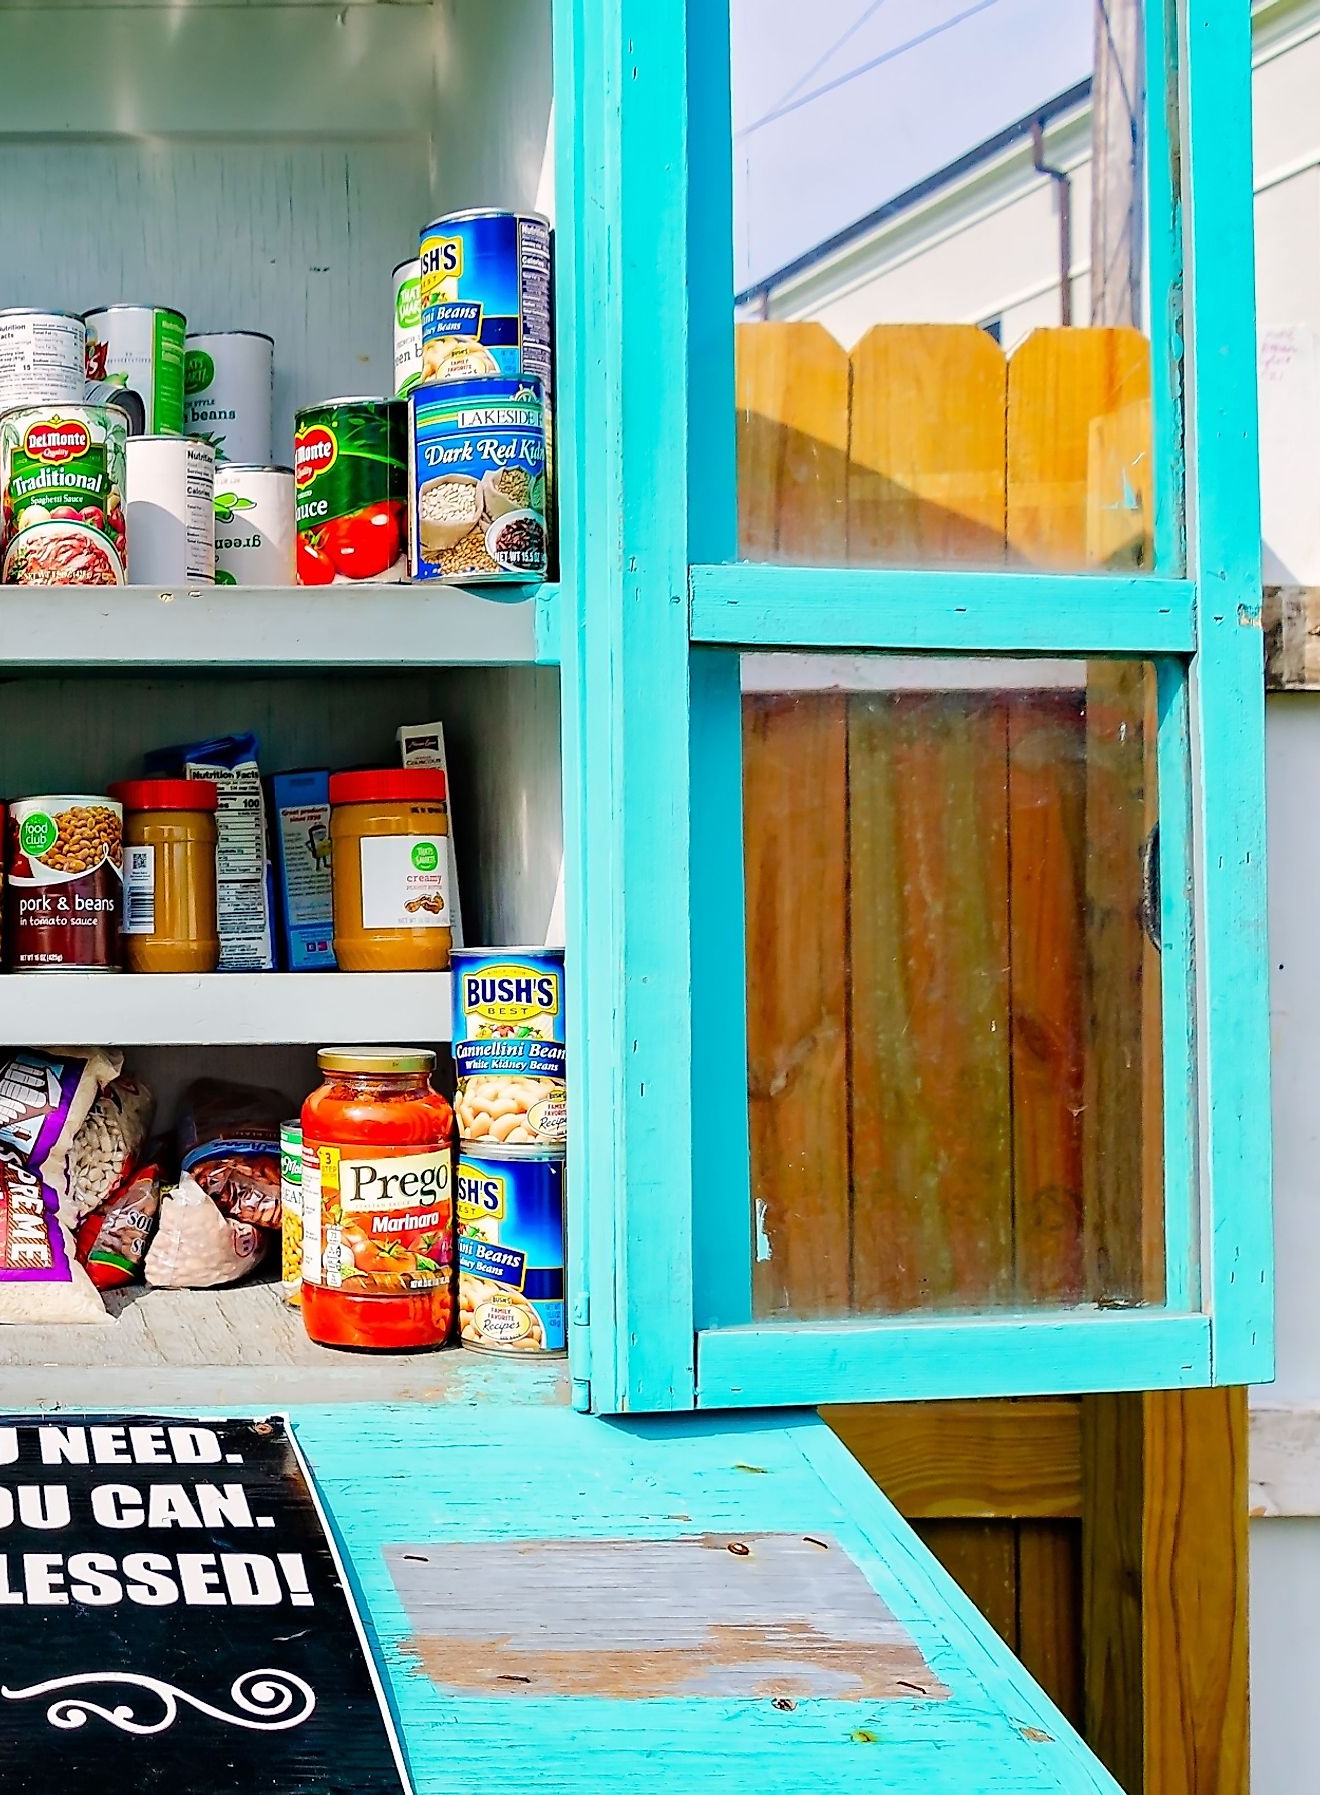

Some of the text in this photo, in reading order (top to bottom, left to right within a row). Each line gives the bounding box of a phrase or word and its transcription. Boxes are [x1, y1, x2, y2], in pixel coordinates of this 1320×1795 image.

[437, 306, 478, 320] Beans
[436, 322, 461, 333] Beans
[191, 407, 237, 423] beans
[460, 409, 536, 427] LAKESIDE
[28, 432, 86, 447] Del Monte
[424, 441, 516, 467] Dark Red
[12, 467, 103, 498] Traditional
[30, 495, 84, 506] Spaghetti Sauce
[215, 534, 262, 549] green
[494, 552, 521, 563] NET WT
[192, 771, 259, 779] Nutrition Facts
[242, 799, 260, 808] 100
[298, 806, 328, 816] products
[25, 821, 49, 835] food
[25, 833, 47, 845] club
[406, 873, 442, 883] creamy
[20, 894, 115, 915] pork & beans
[20, 916, 99, 926] in tomato sauce
[467, 977, 554, 1008] BUSH'S
[487, 1007, 529, 1015] BEST
[456, 1041, 524, 1059] Cannellini
[465, 1059, 559, 1072] White Kidney Beans
[325, 1152, 332, 1164] 3
[350, 1164, 448, 1206] Prego
[372, 1211, 439, 1233] Marinara
[476, 1244, 522, 1268] Beans
[475, 1260, 505, 1276] Beans
[487, 1313, 515, 1322] FAVORITE
[490, 1307, 511, 1315] FAMILY
[482, 1319, 521, 1335] Recipes
[40, 1425, 244, 1465] NEED.
[91, 1483, 275, 1529] CAN.
